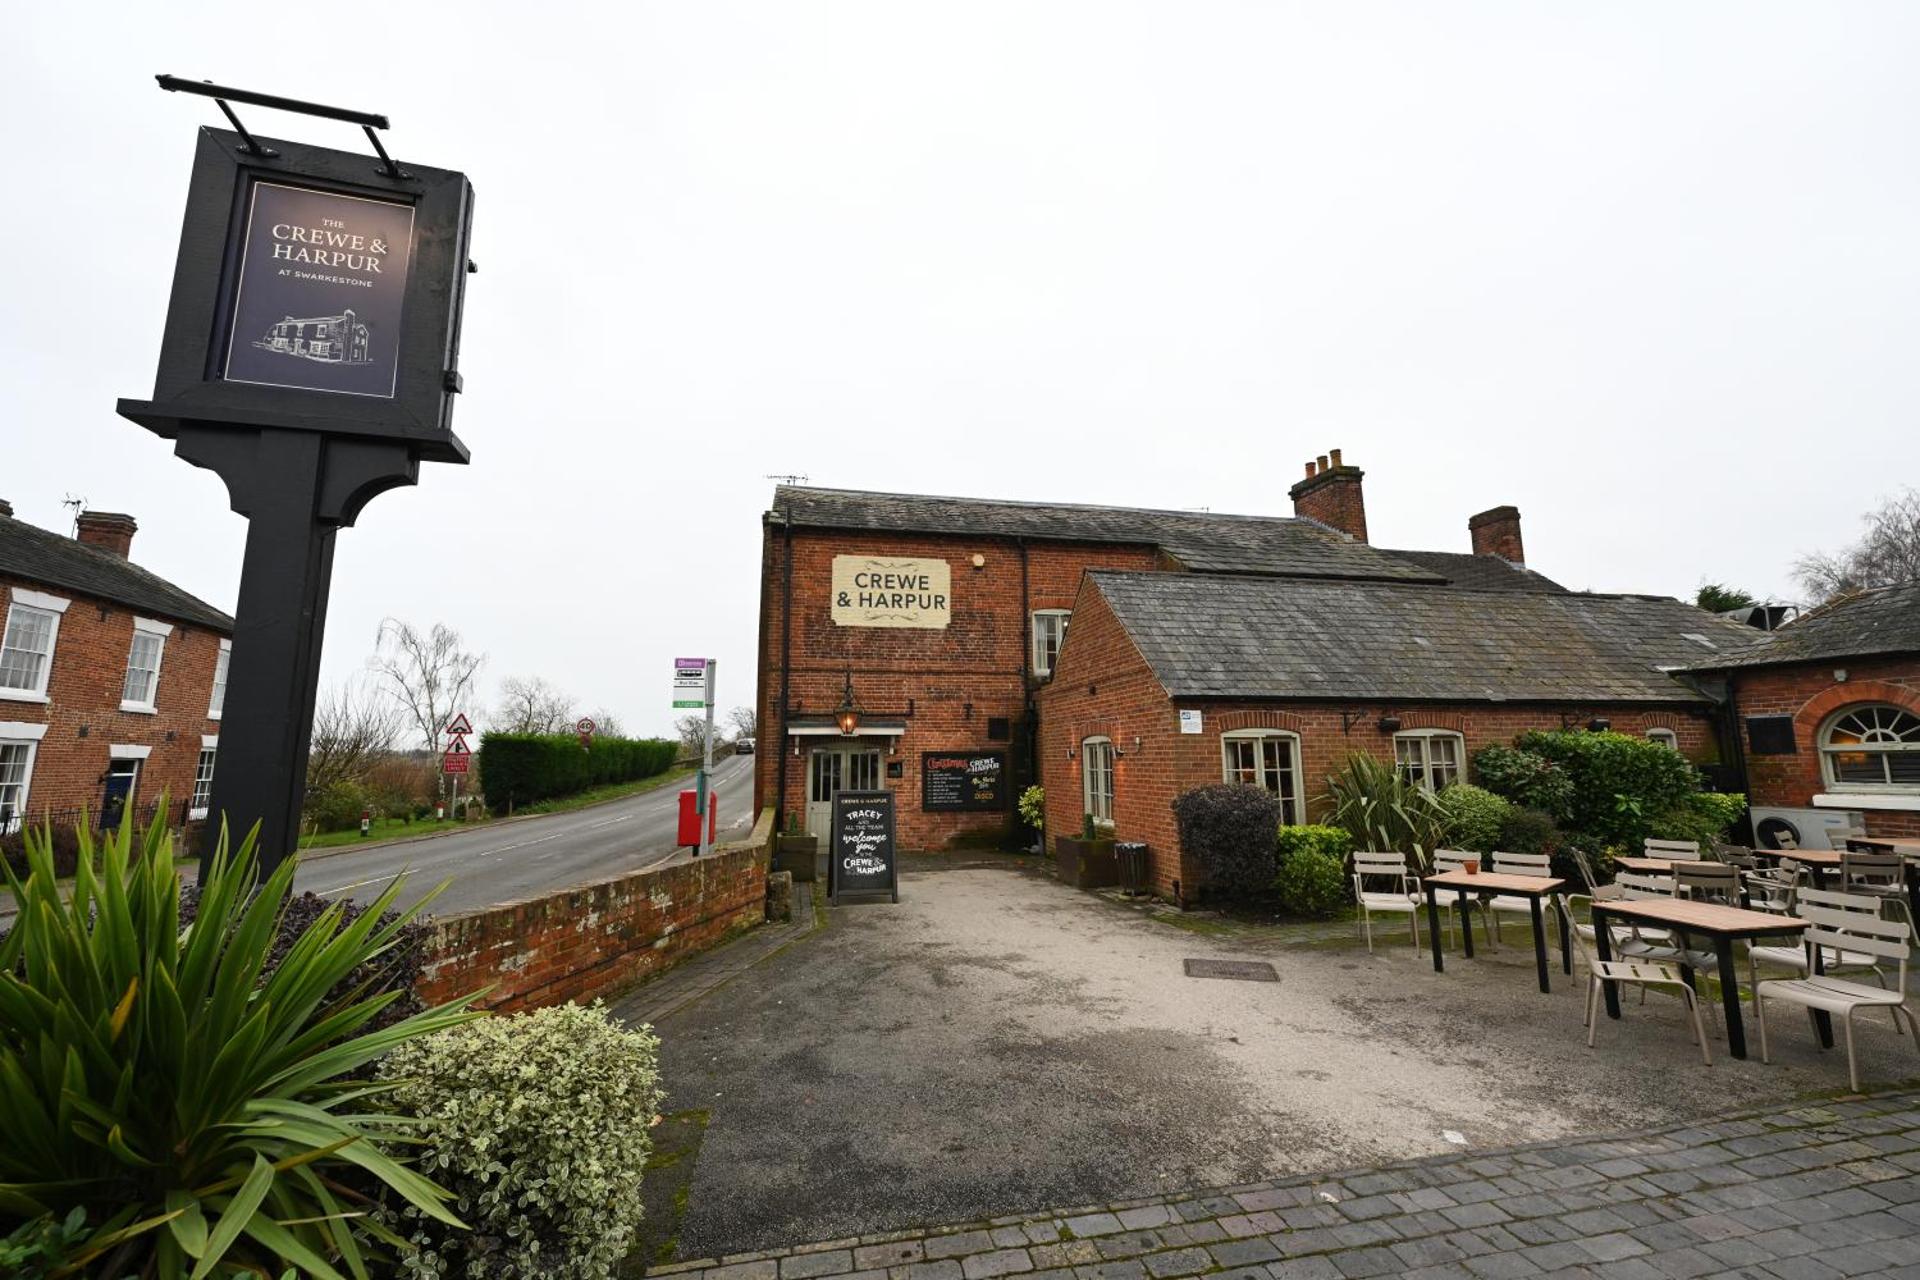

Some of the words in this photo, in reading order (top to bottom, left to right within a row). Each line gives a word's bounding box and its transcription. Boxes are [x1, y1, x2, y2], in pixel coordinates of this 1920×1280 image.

[322, 218, 344, 229] THE
[272, 223, 364, 251] CREWE
[369, 238, 388, 255] &
[272, 243, 382, 273] HARPUR
[278, 268, 291, 276] AT
[295, 270, 373, 288] SWARKESTONE
[855, 573, 929, 590] CREWE
[837, 591, 851, 607] &
[859, 592, 946, 610] HARPUR
[846, 809, 883, 820] TRACEY
[843, 831, 887, 844] welcome
[855, 843, 877, 854] you
[843, 858, 873, 869] CREWE
[857, 863, 887, 874] HARPUR
